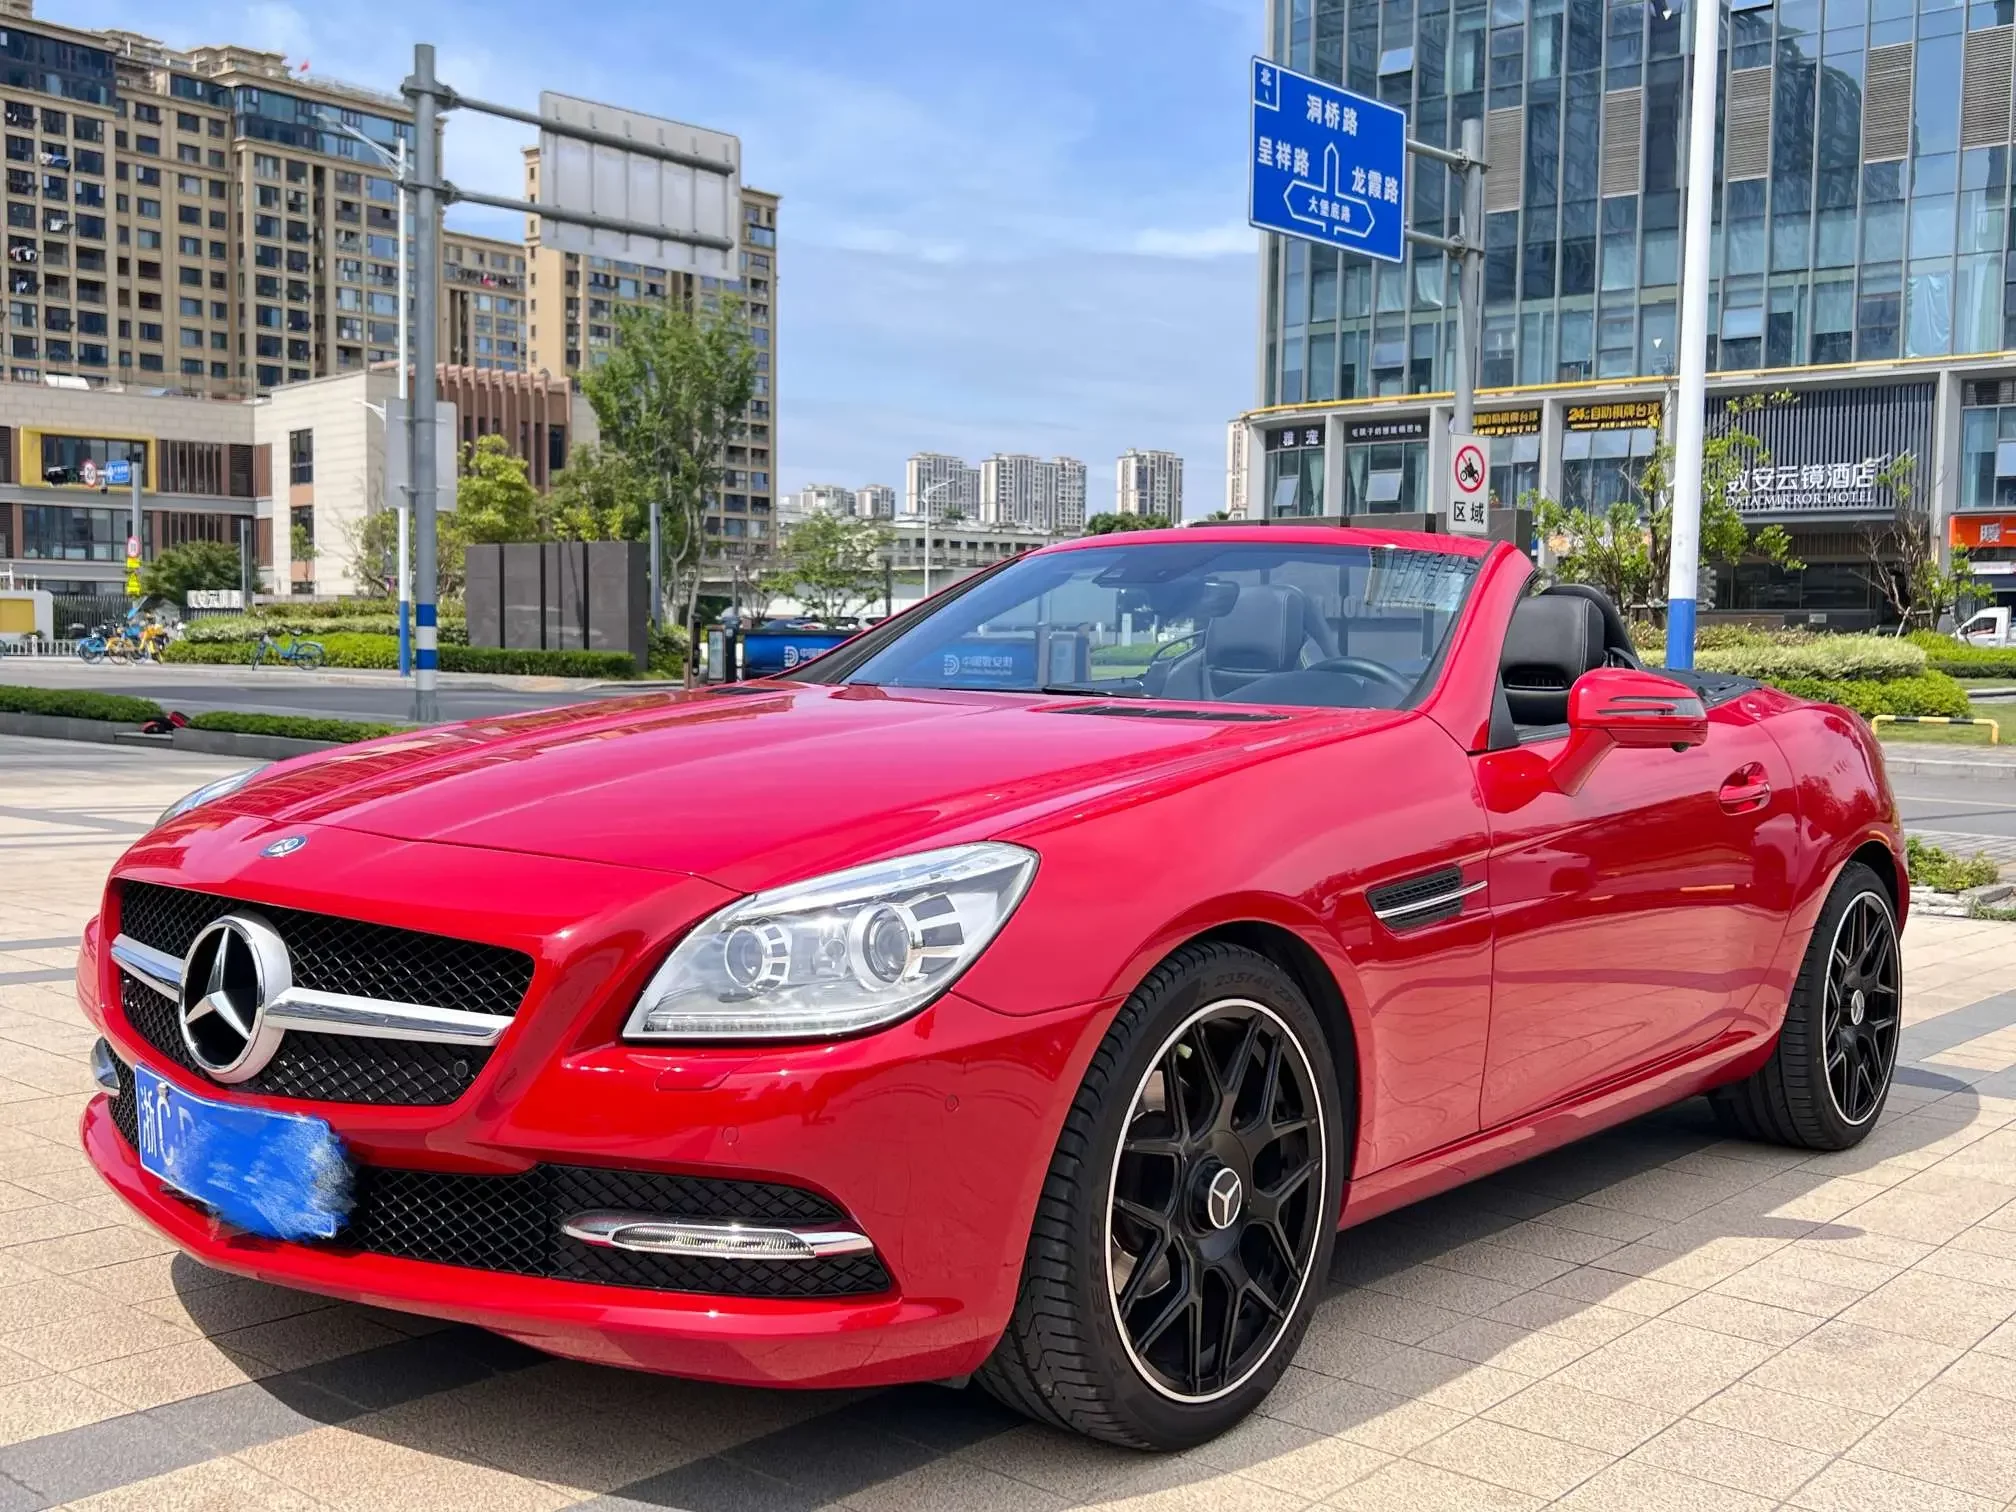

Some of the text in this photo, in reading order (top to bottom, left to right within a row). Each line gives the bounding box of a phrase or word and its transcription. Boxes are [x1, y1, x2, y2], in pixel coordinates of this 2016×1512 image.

[1260, 68, 1272, 86] 北
[1306, 93, 1358, 136] 洞桥路
[1257, 136, 1310, 178] 呈祥路
[1351, 166, 1399, 205] 龙霞路
[1726, 463, 1875, 493] 数安云镜酒店
[1454, 501, 1484, 525] 区域
[1726, 490, 1873, 508] DATA MIRROR HOTEL
